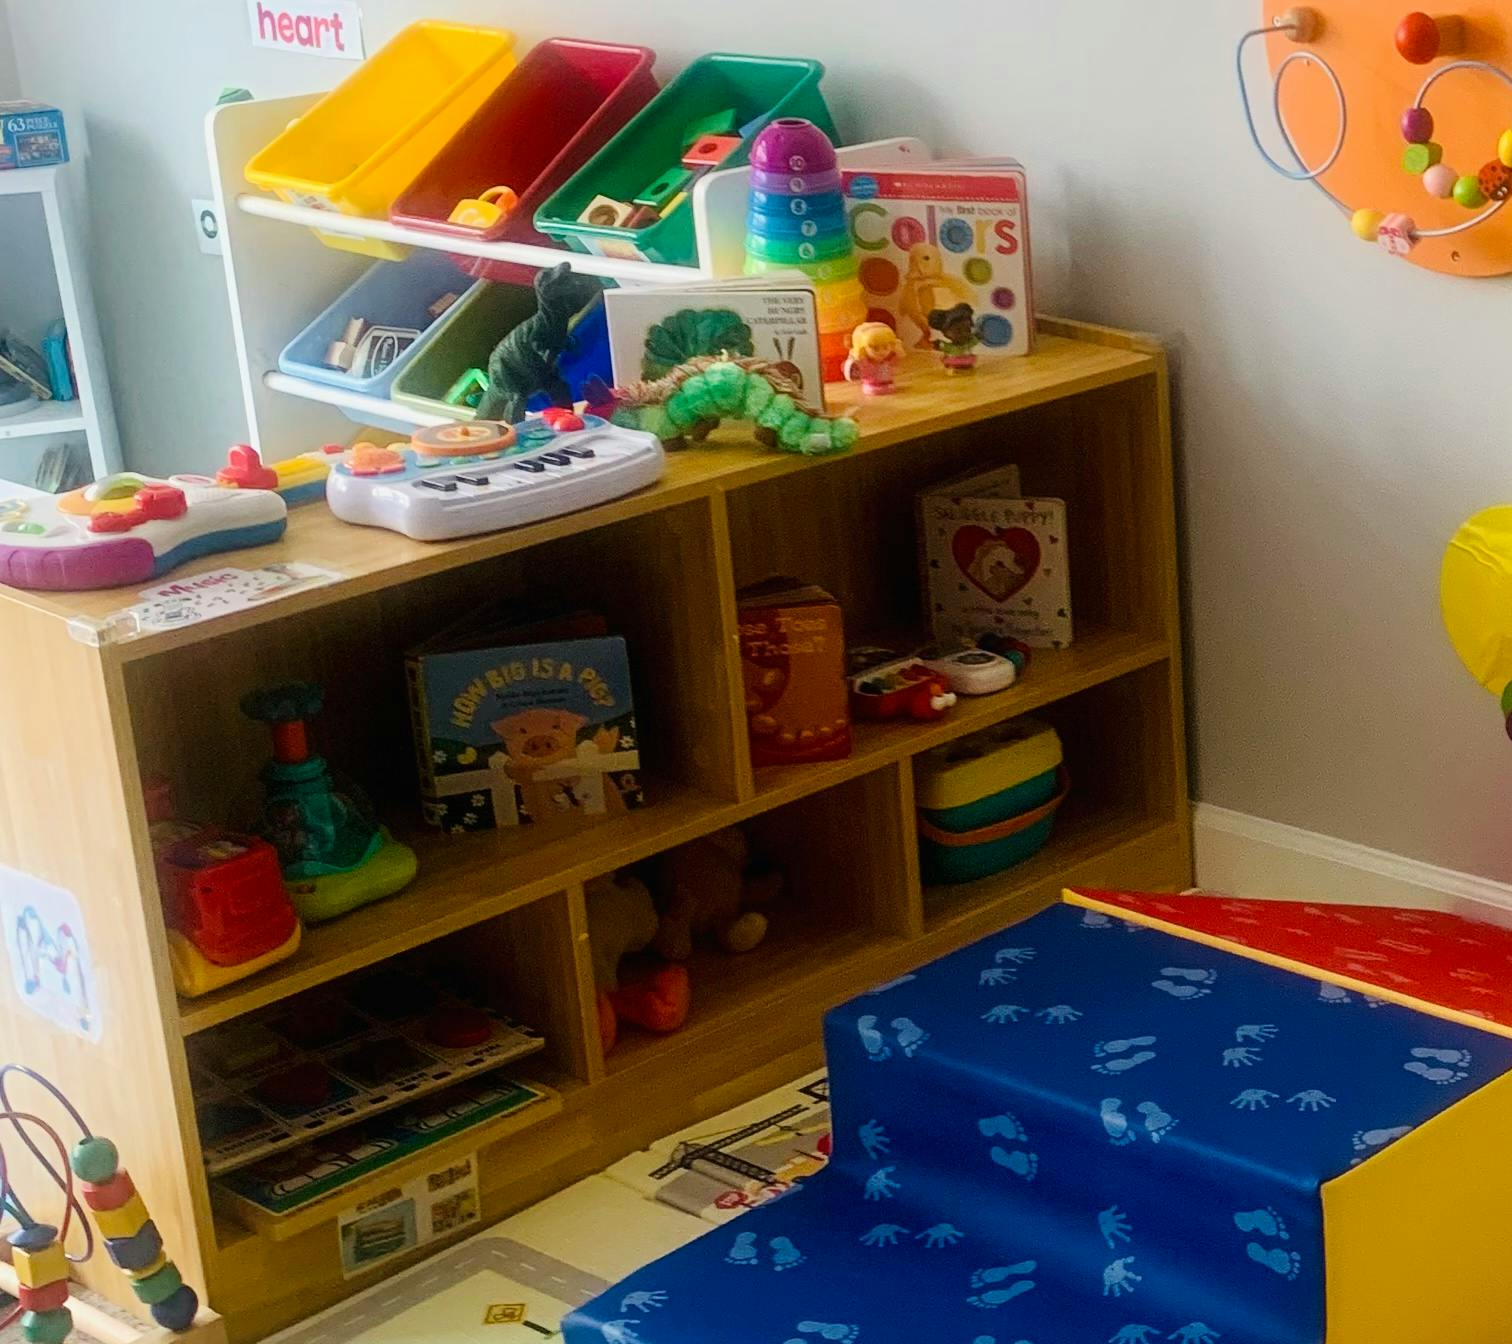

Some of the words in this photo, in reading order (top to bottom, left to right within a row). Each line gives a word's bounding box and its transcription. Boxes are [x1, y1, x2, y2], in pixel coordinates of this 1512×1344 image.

[257, 2, 345, 52] heart
[8, 118, 26, 132] 63
[850, 202, 1018, 255] Colors
[450, 678, 488, 728] HOW
[485, 661, 526, 689] BIG
[532, 657, 553, 680] IS
[559, 661, 573, 682] A
[577, 666, 617, 708] PIG
